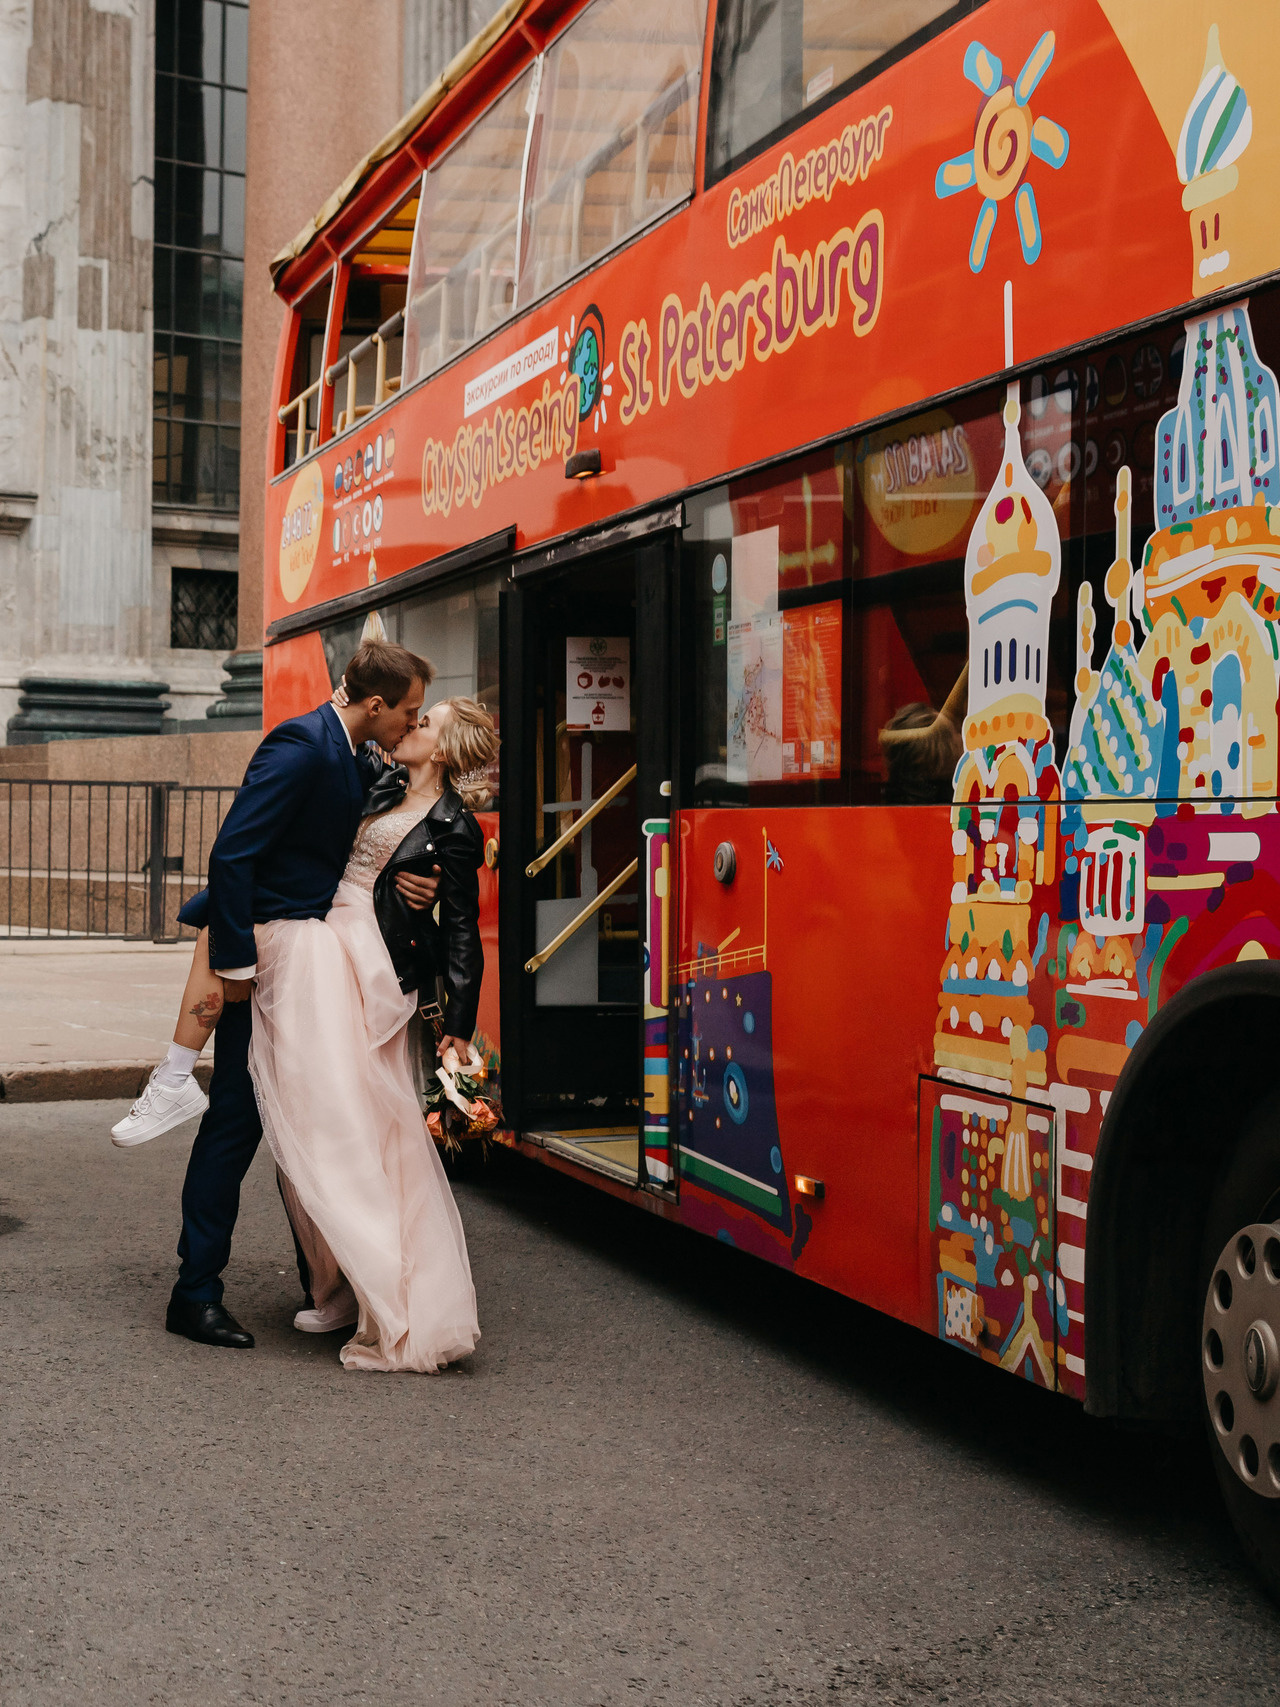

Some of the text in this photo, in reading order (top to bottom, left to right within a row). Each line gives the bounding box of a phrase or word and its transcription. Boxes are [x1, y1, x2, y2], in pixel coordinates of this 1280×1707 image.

[727, 105, 893, 249] Санкт-Петербург
[466, 339, 556, 406] экскурсии по городу
[620, 208, 884, 425] St Petersburg
